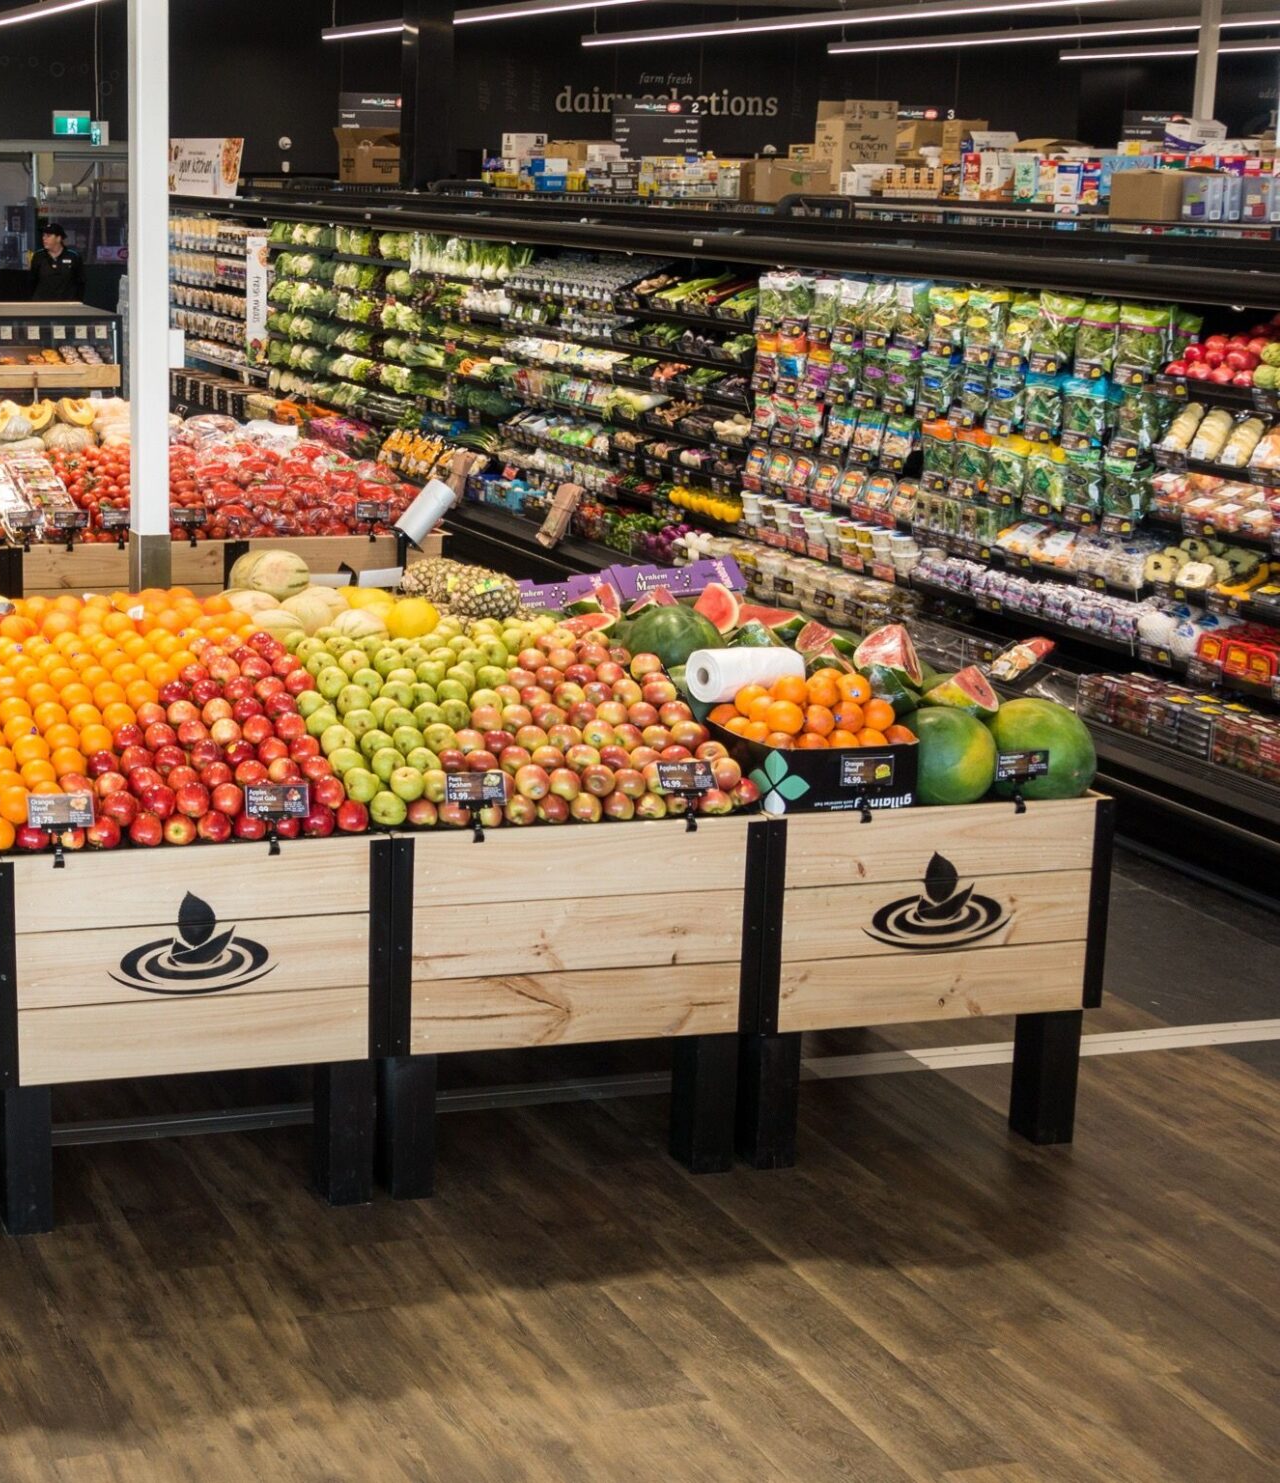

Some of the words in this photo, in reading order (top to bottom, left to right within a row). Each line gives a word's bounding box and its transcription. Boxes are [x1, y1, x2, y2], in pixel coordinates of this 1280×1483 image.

[639, 72, 664, 85] farm
[667, 72, 693, 85] fresh
[555, 85, 632, 113] dair
[691, 102, 700, 113] 2
[947, 109, 955, 119] 3
[849, 141, 888, 151] CRUNCHY
[860, 151, 878, 159] NUT
[636, 571, 668, 581] Arnhem
[520, 589, 544, 598] rnhem
[659, 764, 677, 772] Apples
[677, 764, 688, 772] Fuji
[662, 780, 681, 788] $6.99
[449, 792, 468, 800] $3.99
[32, 816, 54, 824] $3.79
